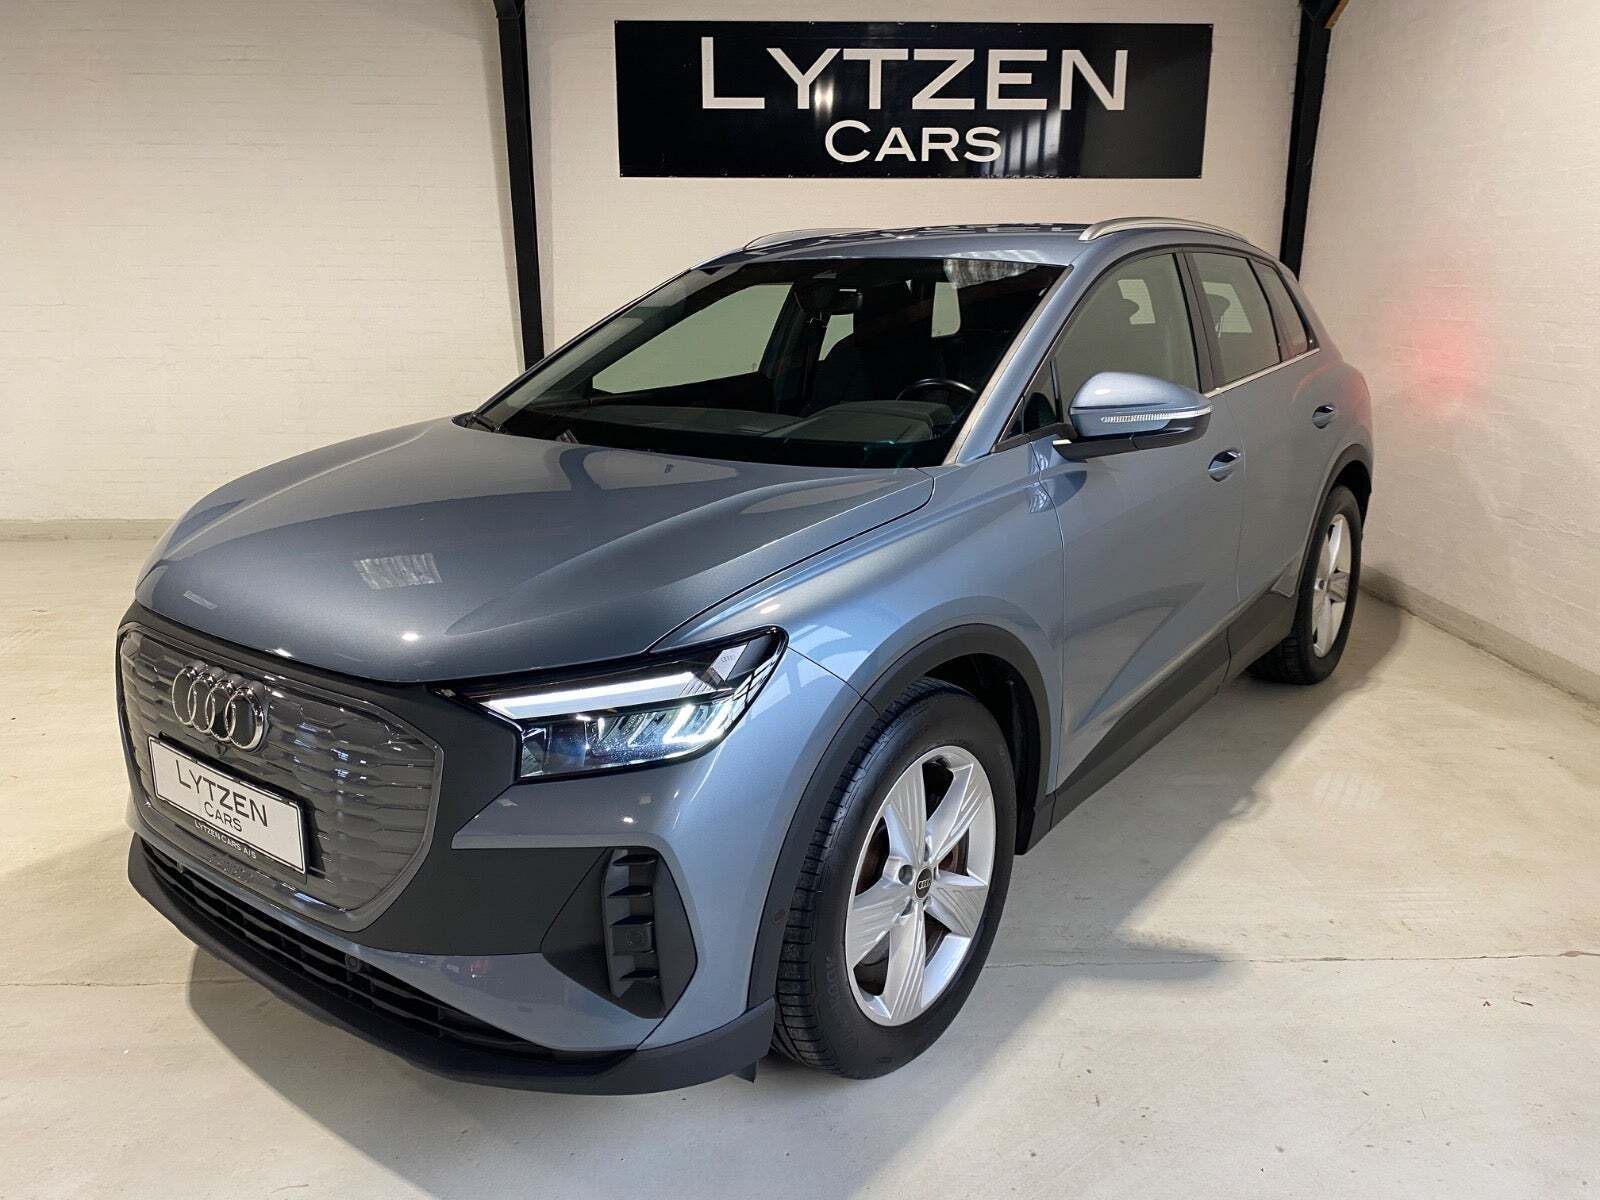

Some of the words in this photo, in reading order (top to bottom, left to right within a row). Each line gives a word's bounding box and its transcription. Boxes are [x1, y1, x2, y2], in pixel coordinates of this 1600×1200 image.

[701, 36, 1128, 111] LYTZEN
[824, 119, 1002, 163] CARS
[176, 759, 268, 827] LYTZEN
[194, 820, 221, 840] LYTZEN
[221, 835, 241, 850] CARS
[204, 801, 243, 832] CARS
